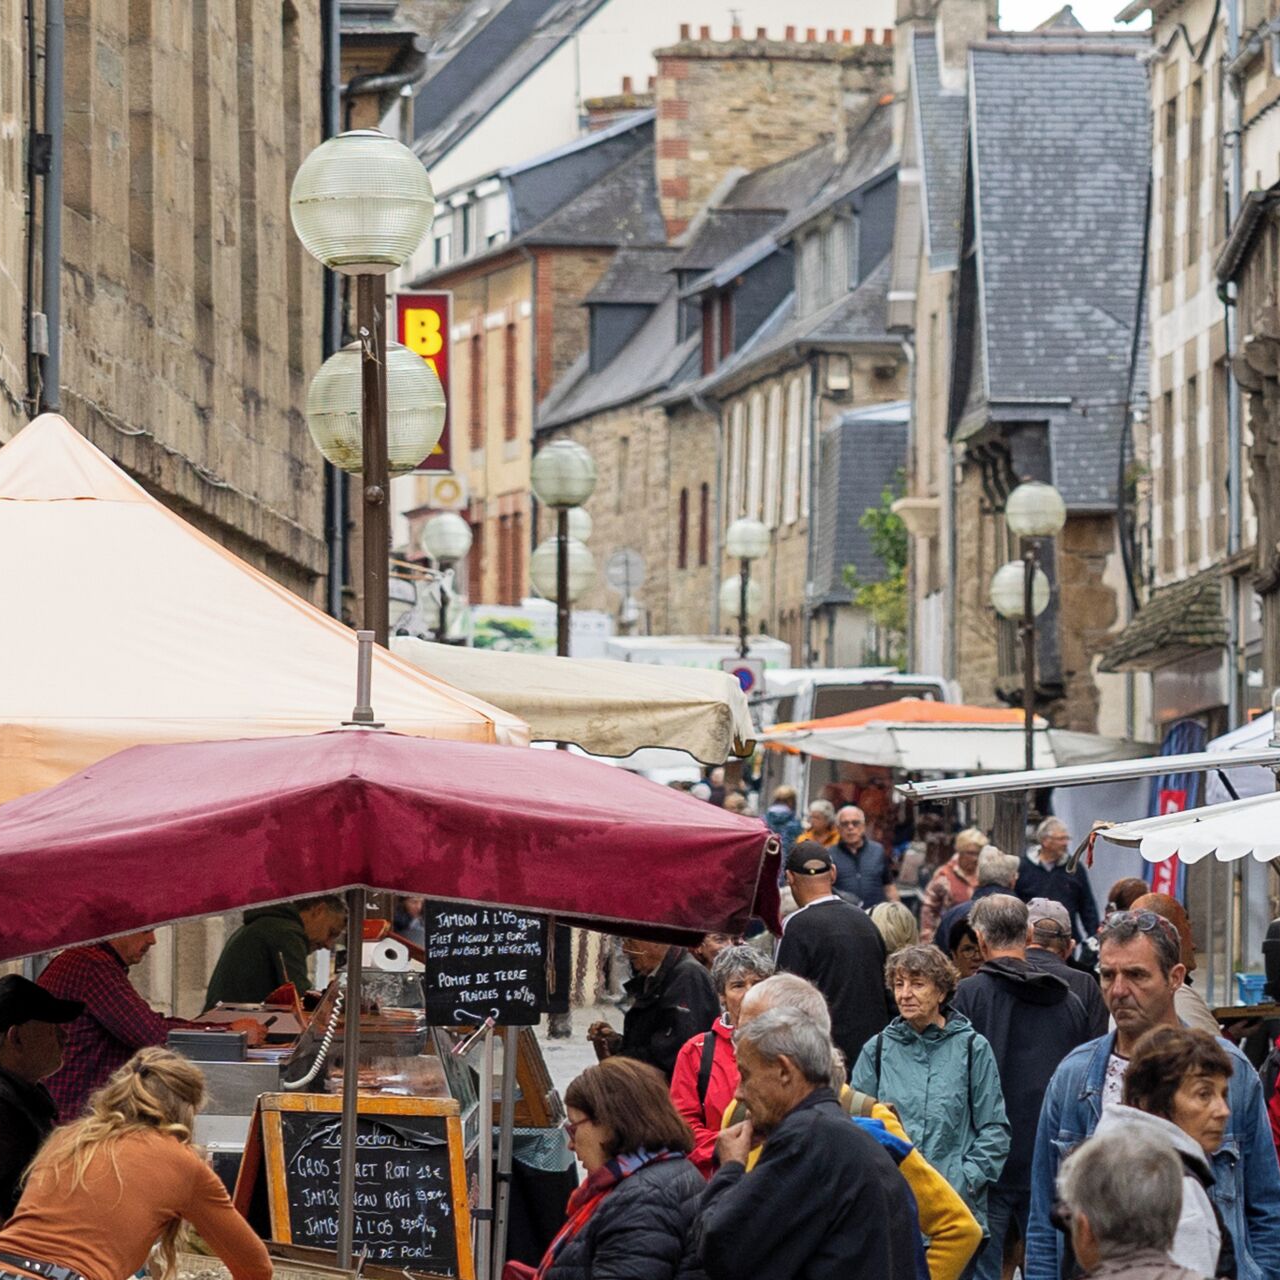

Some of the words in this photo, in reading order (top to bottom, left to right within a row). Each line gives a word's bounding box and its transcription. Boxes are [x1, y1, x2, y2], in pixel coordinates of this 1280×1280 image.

[435, 912, 478, 928] JAMBON
[482, 910, 490, 925] À
[493, 911, 517, 925] L'OS
[429, 932, 453, 945] FILET
[492, 933, 504, 943] DE
[482, 945, 495, 957] DE
[438, 972, 472, 988] POMME
[475, 973, 490, 985] DE
[493, 969, 528, 982] TERRE
[356, 1122, 400, 1146] ochon
[297, 1155, 330, 1179] GROS
[332, 1159, 379, 1178] JRET
[367, 1219, 394, 1236] L'OS
[379, 1247, 395, 1259] DE
